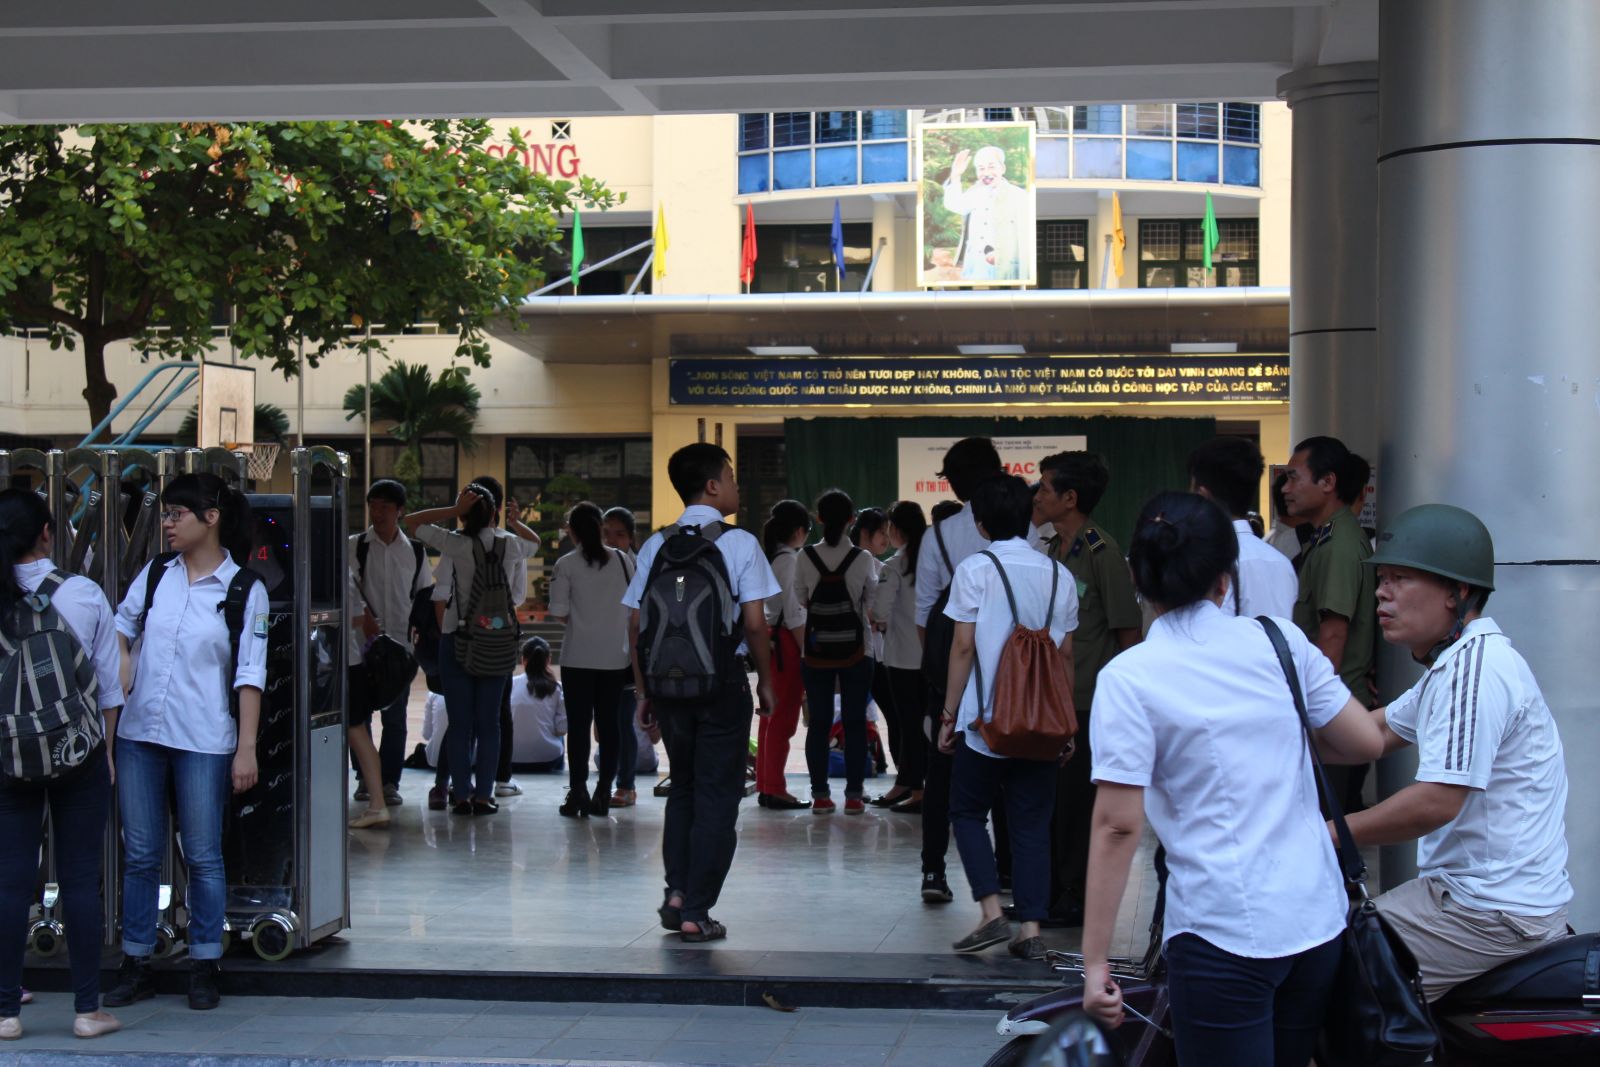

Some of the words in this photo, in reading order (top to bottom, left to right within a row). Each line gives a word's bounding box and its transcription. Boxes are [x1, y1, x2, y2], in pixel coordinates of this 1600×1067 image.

[754, 369, 775, 381] VIỆT
[778, 371, 802, 380] NAM
[805, 369, 819, 380] CÓ
[918, 370, 940, 379] HAY
[942, 367, 982, 380] KHÔNG,
[984, 367, 1007, 378] DÂN
[1010, 367, 1032, 380] TỘC
[1034, 366, 1057, 380] VIỆT
[1060, 369, 1086, 378] NAM
[1088, 366, 1104, 378] CÓ
[1179, 367, 1204, 377] VINH
[1207, 366, 1245, 378] QUANG
[707, 383, 729, 395] CÁC
[891, 385, 912, 395] HAY
[914, 383, 954, 396] KHÔNG,
[1231, 380, 1254, 392] CÁC
